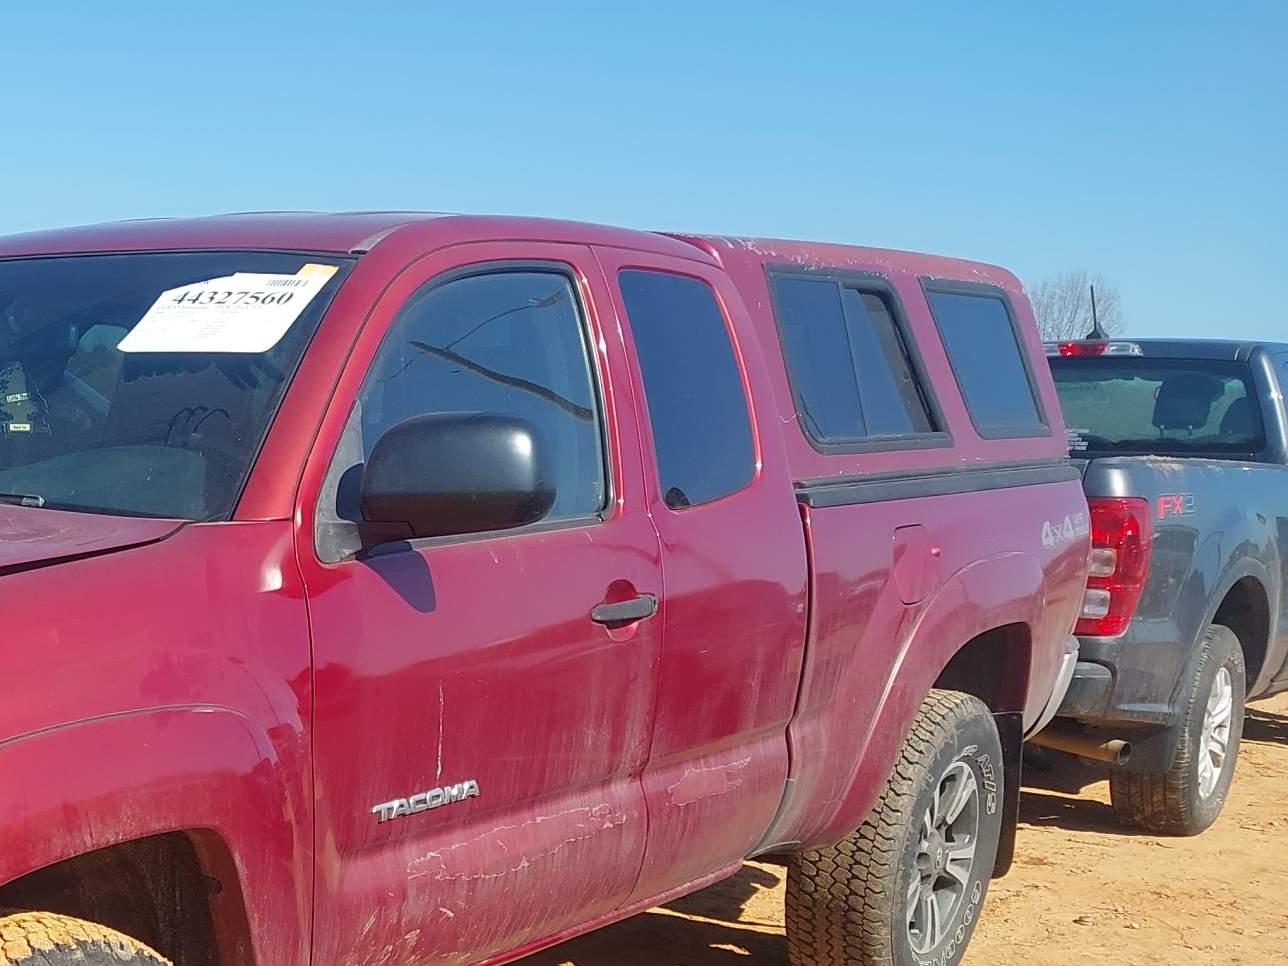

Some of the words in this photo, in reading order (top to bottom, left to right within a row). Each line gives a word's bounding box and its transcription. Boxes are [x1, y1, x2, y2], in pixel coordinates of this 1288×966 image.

[172, 289, 295, 306] 44327560
[1156, 492, 1197, 520] FX2
[371, 779, 481, 824] TACOMA
